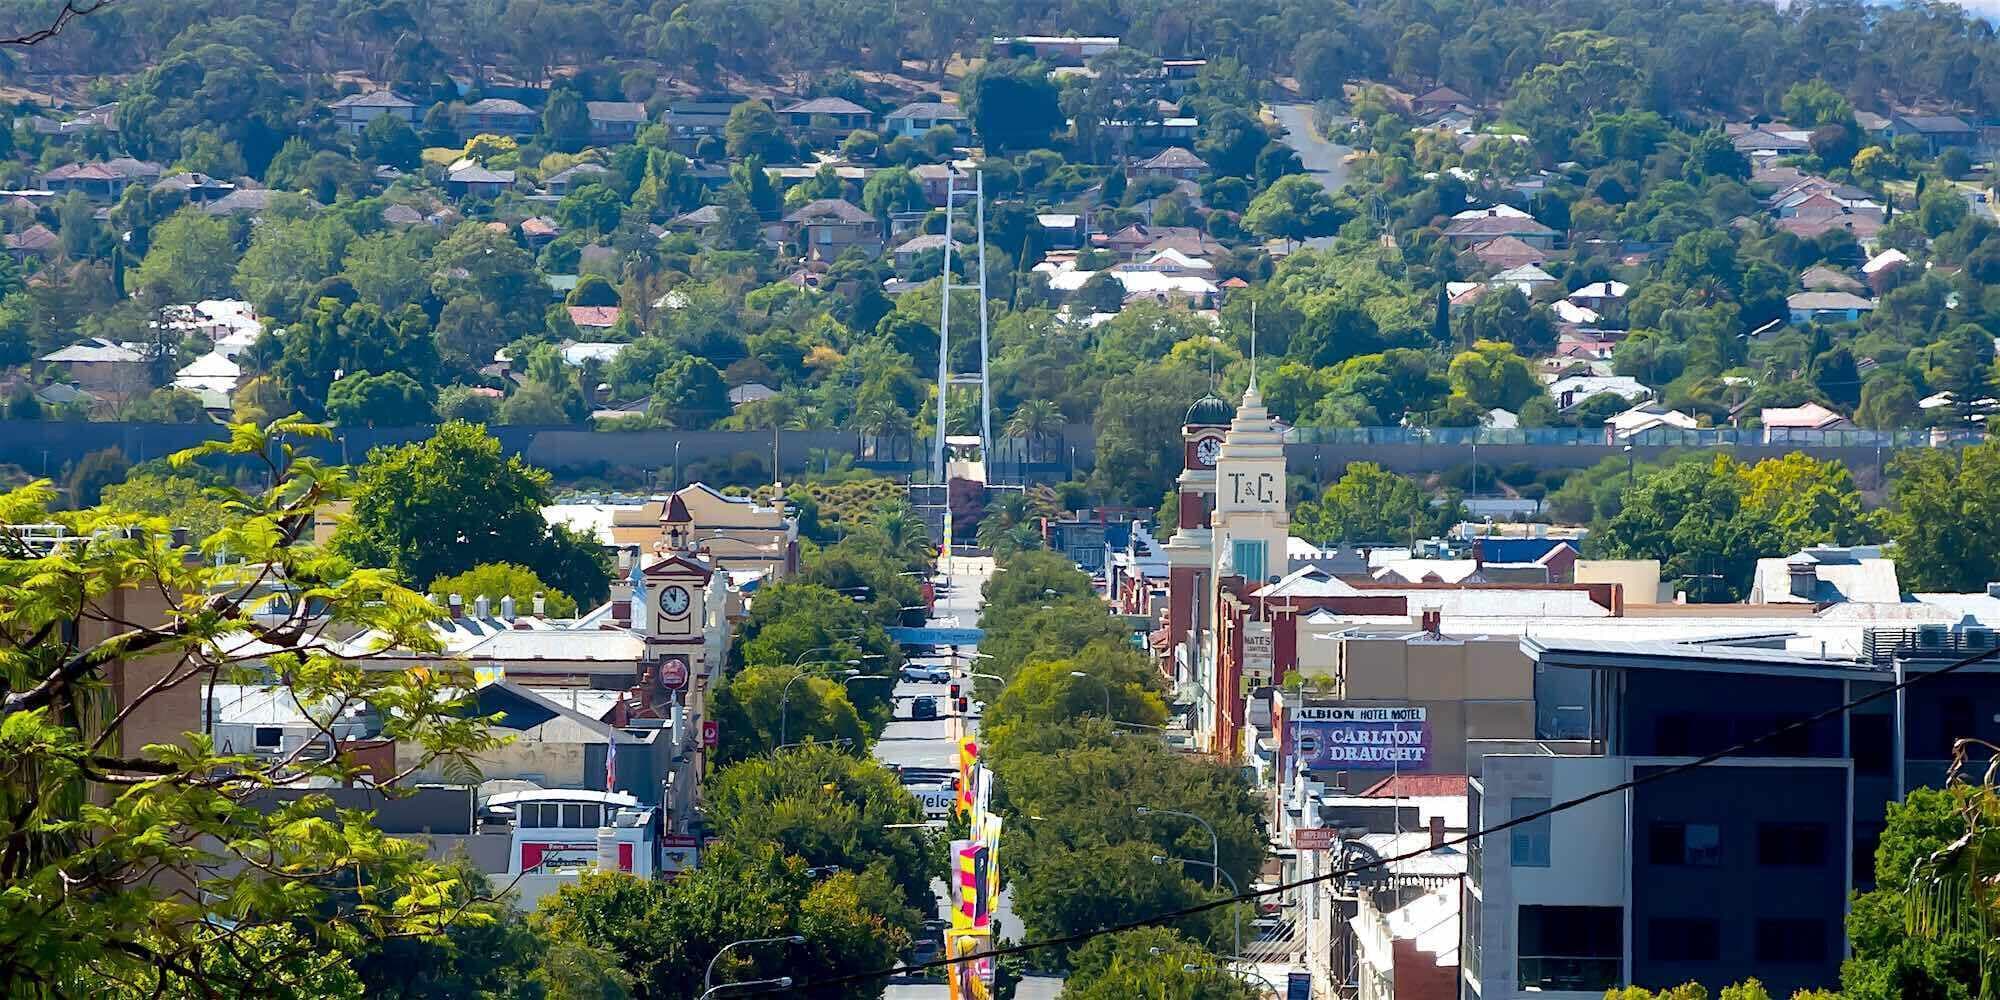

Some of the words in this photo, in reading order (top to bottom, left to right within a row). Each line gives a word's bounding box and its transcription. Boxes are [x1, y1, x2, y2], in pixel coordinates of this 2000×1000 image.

[1297, 709, 1354, 719] ALBION
[1360, 709, 1387, 719] HOTEL
[1391, 709, 1420, 719] MOTEL
[1331, 730, 1423, 745] CARLTON
[1329, 747, 1426, 760] DRAUGHT
